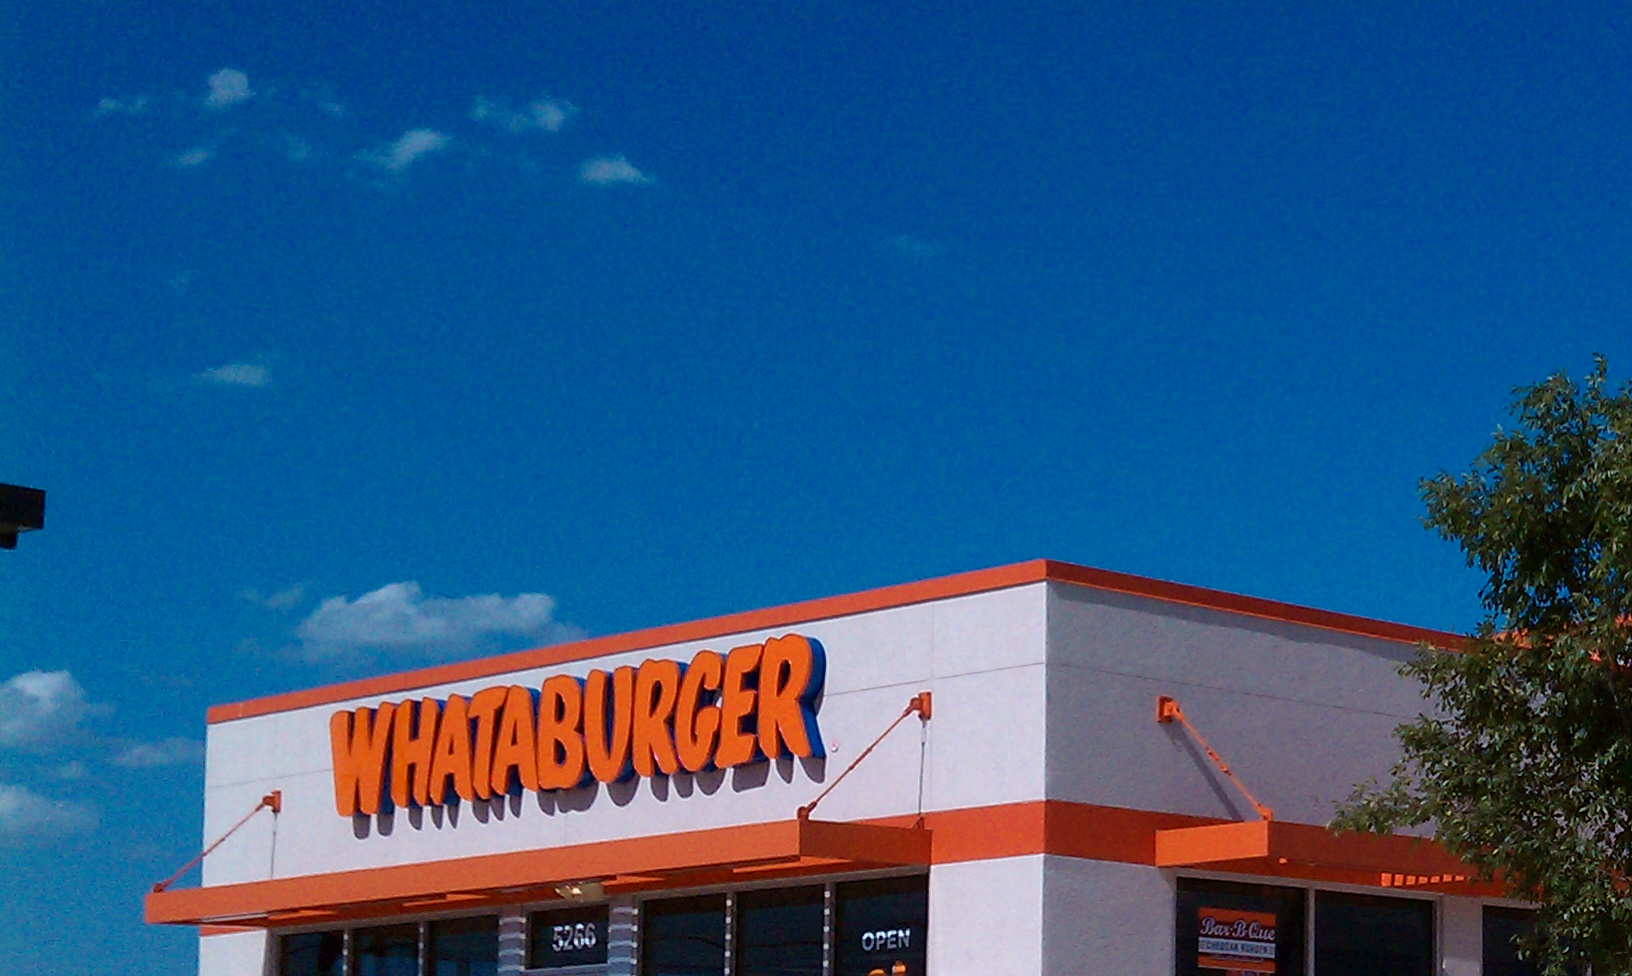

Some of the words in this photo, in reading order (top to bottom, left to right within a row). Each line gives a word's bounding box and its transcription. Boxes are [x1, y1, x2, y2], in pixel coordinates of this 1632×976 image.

[330, 634, 824, 817] WHATABURGER
[552, 923, 597, 951] 5266
[862, 928, 911, 951] OPEN
